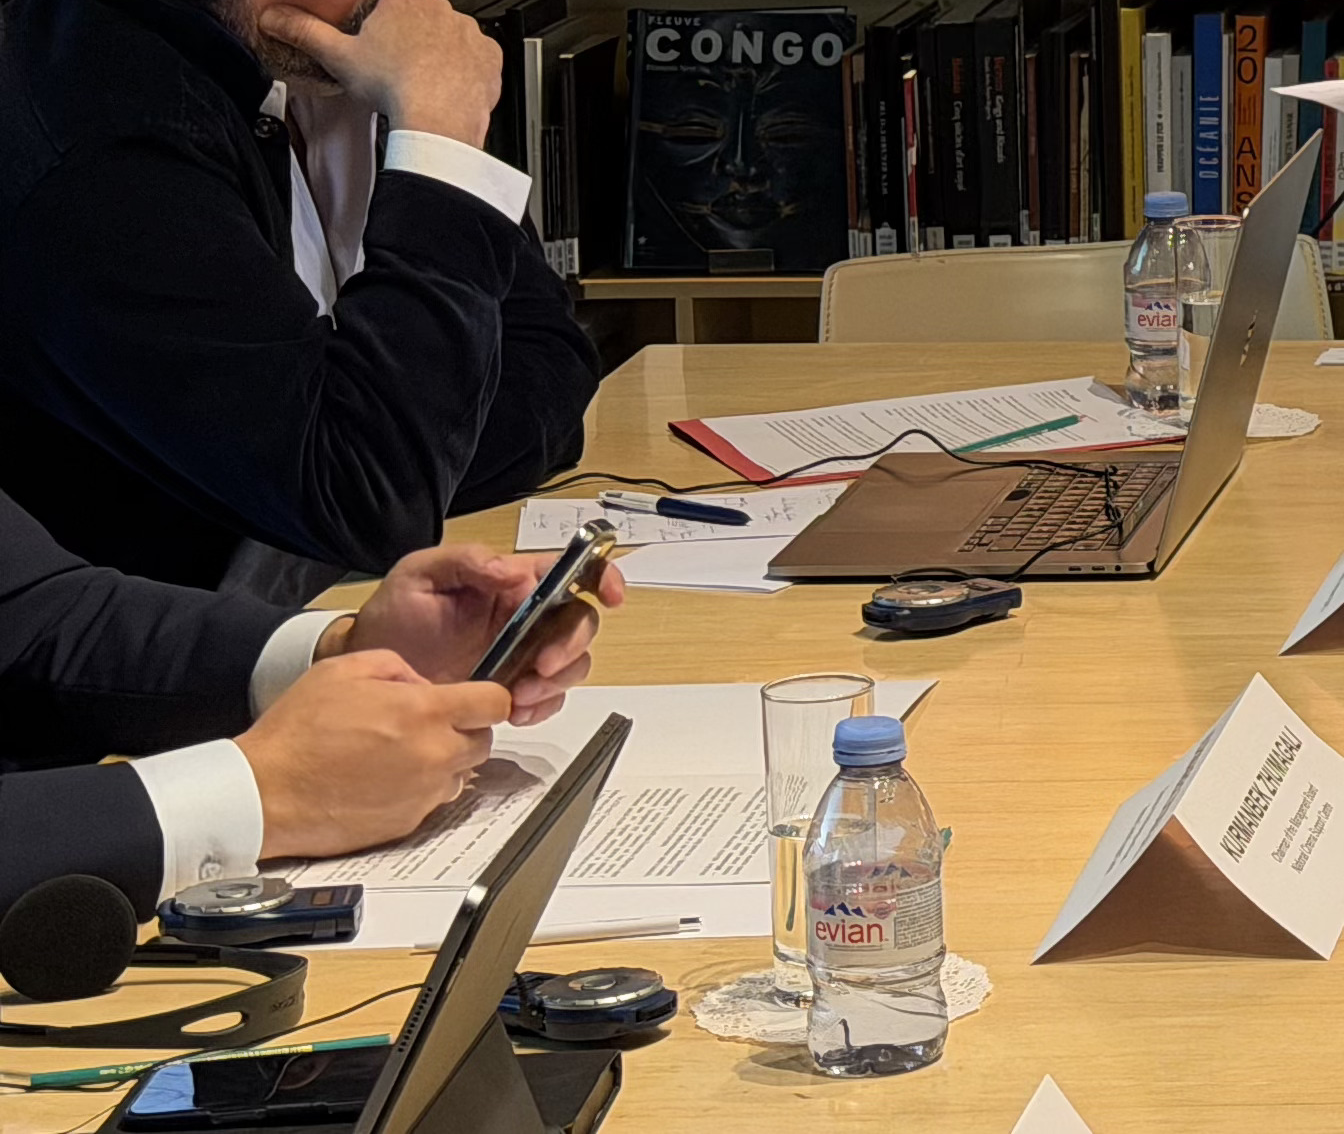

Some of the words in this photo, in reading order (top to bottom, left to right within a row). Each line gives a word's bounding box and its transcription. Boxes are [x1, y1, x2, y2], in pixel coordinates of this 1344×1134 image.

[648, 16, 701, 27] FLEUVE
[645, 28, 844, 66] CONGO
[1236, 24, 1259, 85] 20
[1196, 94, 1220, 179] OCÉANIE
[1219, 780, 1273, 864] KURMANBEK
[1256, 724, 1303, 797] ZHUMAGALI
[1281, 828, 1295, 843] of
[1284, 820, 1298, 838] the
[1308, 812, 1329, 841] Support
[1299, 830, 1318, 856] Cinema
[1290, 847, 1310, 876] National
[815, 919, 883, 943] evian
